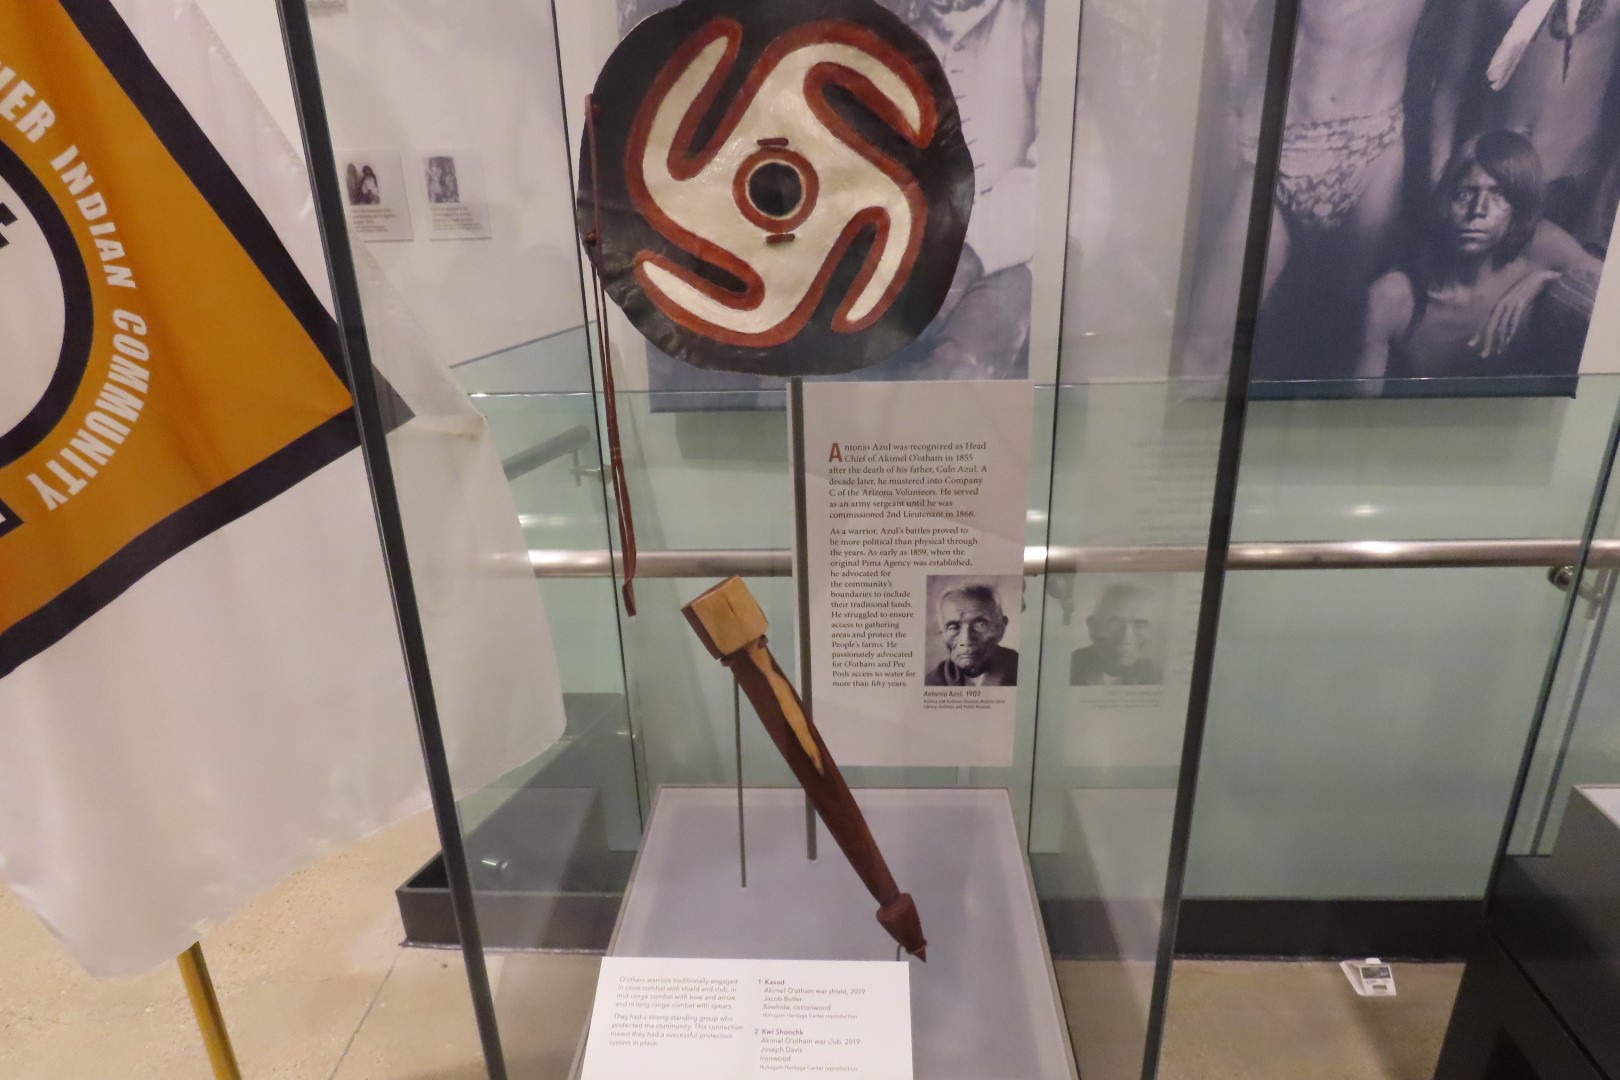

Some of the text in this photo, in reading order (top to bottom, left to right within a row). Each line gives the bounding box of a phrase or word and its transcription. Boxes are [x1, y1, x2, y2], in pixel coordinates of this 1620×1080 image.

[50, 145, 136, 289] INDIAN
[26, 308, 151, 510] COMMUNITY
[872, 443, 891, 451] Azul
[910, 442, 953, 453] recognized
[878, 454, 907, 462] Akimel
[909, 454, 943, 462] O'otham
[829, 466, 846, 474] after
[848, 466, 861, 474] the
[862, 466, 884, 474] death
[910, 465, 934, 473] father,
[936, 465, 955, 473] Culo
[957, 465, 978, 473] Azul.
[829, 477, 856, 485] decade
[857, 477, 875, 485] later,
[878, 477, 887, 485] he
[889, 477, 925, 485] mustered
[944, 477, 983, 486] Company
[862, 489, 893, 497] Arizona
[895, 488, 938, 496] Volunteers.
[873, 501, 904, 509] sergeant
[926, 499, 936, 507] he
[956, 510, 975, 518] 1866.
[932, 527, 958, 536] proved
[830, 538, 839, 546] be
[862, 538, 892, 547] political
[915, 537, 945, 547] physical
[947, 537, 978, 546] through
[879, 549, 898, 558] early
[830, 559, 859, 568] original
[883, 560, 911, 568] Agency
[844, 580, 892, 589] community's
[844, 611, 878, 620] struggled
[865, 621, 899, 630] gathering
[832, 641, 860, 649] People's
[832, 651, 875, 659] passionately
[871, 680, 886, 688] fifty
[761, 1046, 784, 1054] Joseph
